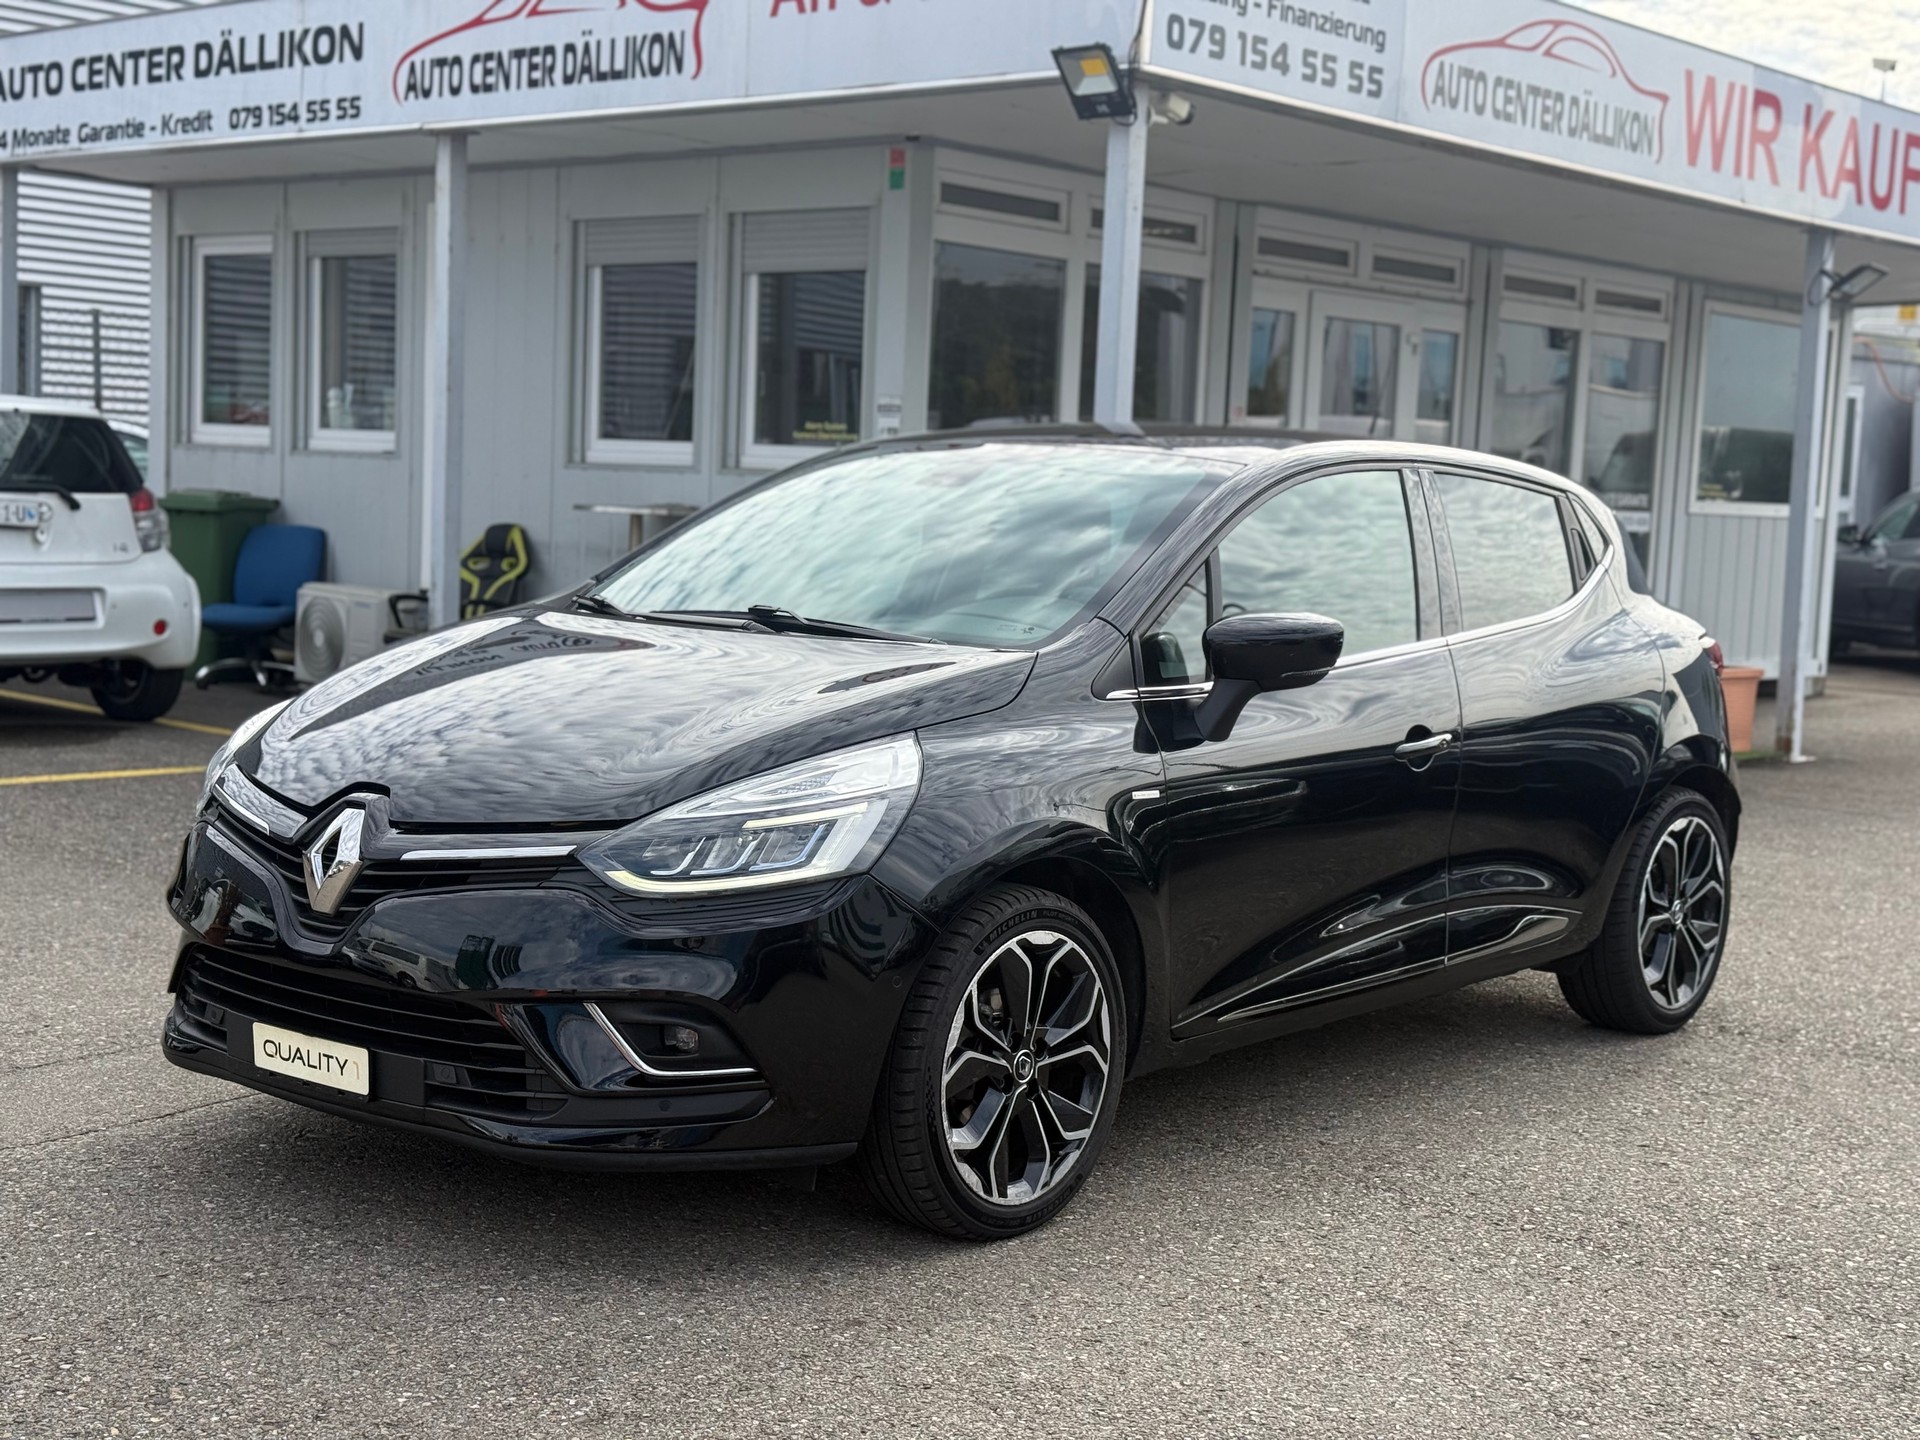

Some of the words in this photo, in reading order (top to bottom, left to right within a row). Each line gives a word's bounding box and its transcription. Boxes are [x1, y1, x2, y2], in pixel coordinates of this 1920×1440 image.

[71, 45, 184, 92] CENTER
[194, 22, 364, 78] DÄLLIKON
[1166, 13, 1226, 60] 079
[1237, 30, 1290, 77] 154
[1301, 48, 1338, 88] 55
[1348, 60, 1384, 98] 55
[1267, 0, 1386, 53] Finanzierung
[404, 55, 463, 101] AUTO
[469, 44, 556, 94] CENTER
[562, 29, 685, 85] DÄLLIKON
[12, 123, 70, 149] Monate
[78, 117, 145, 144] Garantie
[161, 110, 213, 136] Kredit
[229, 106, 262, 130] 079
[268, 102, 299, 126] 154
[305, 99, 330, 123] 55
[336, 97, 361, 120] 55
[1432, 60, 1488, 116] AUTO
[1491, 76, 1565, 135] CENTER
[1567, 89, 1655, 156] DÄLLIKON
[1684, 68, 1782, 187] WIR
[1798, 102, 1920, 216] KAUF
[989, 909, 1038, 942] MICHELIN
